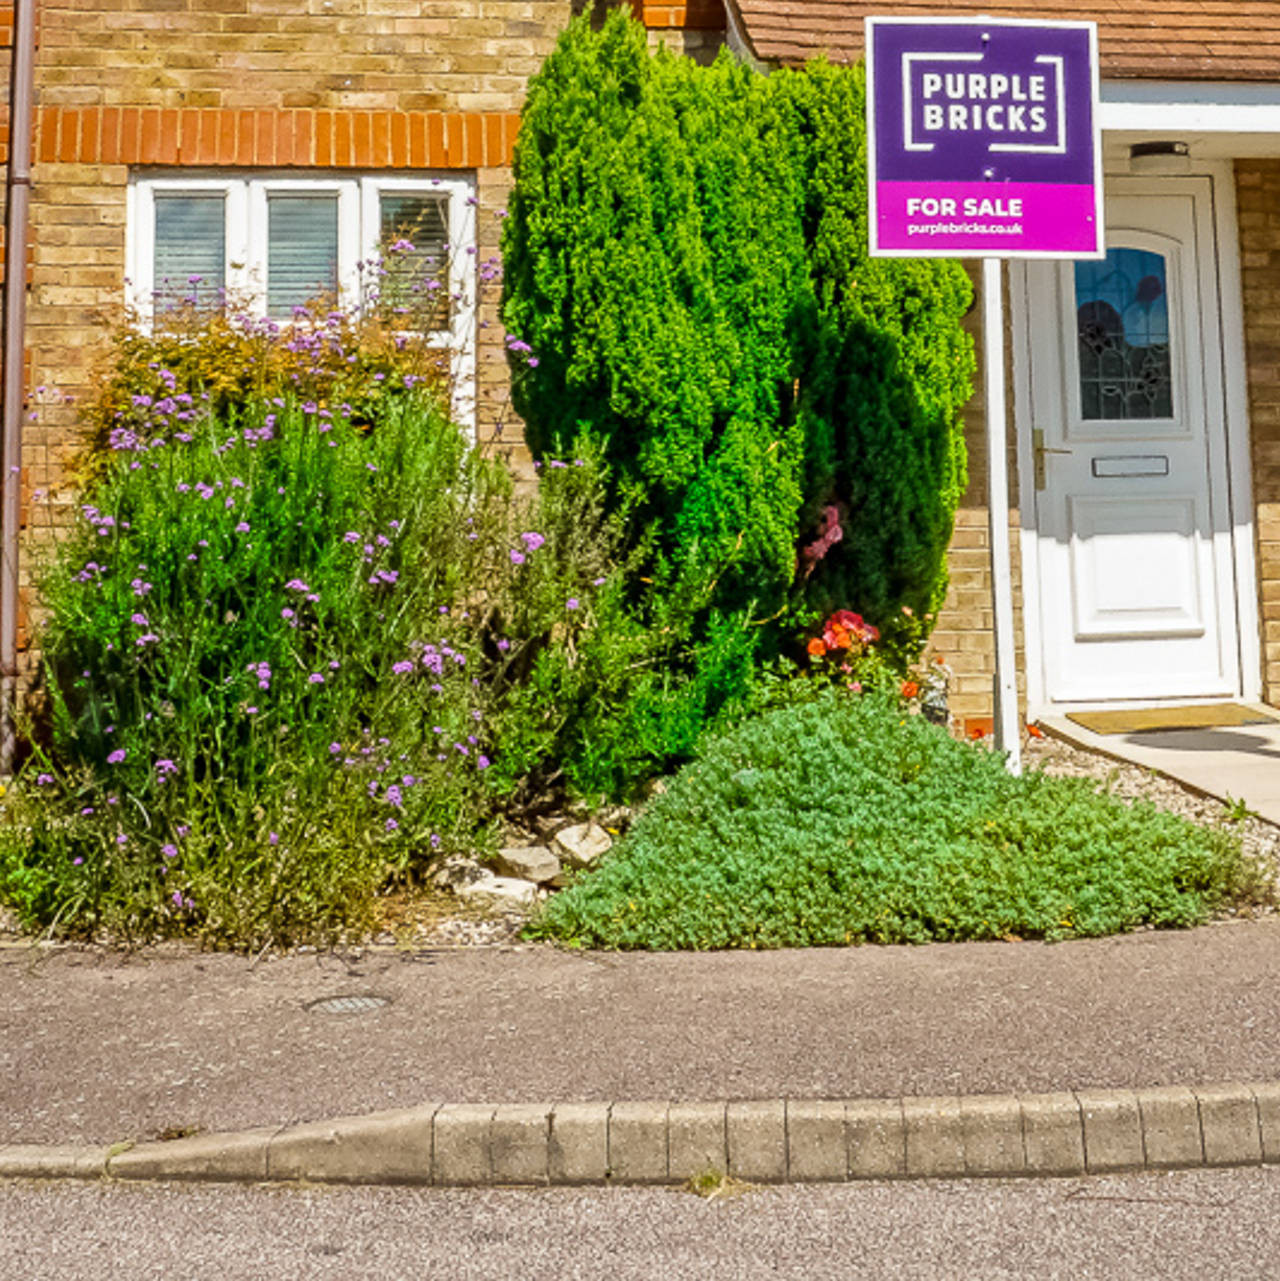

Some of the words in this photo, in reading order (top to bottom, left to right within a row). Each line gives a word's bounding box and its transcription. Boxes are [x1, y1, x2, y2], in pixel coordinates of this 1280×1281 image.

[922, 73, 1046, 101] PURPLE
[923, 104, 1048, 132] BRICKS
[906, 198, 957, 217] FOR
[963, 198, 1023, 217] SALE
[907, 222, 1024, 236] purplebricks.co.uk
